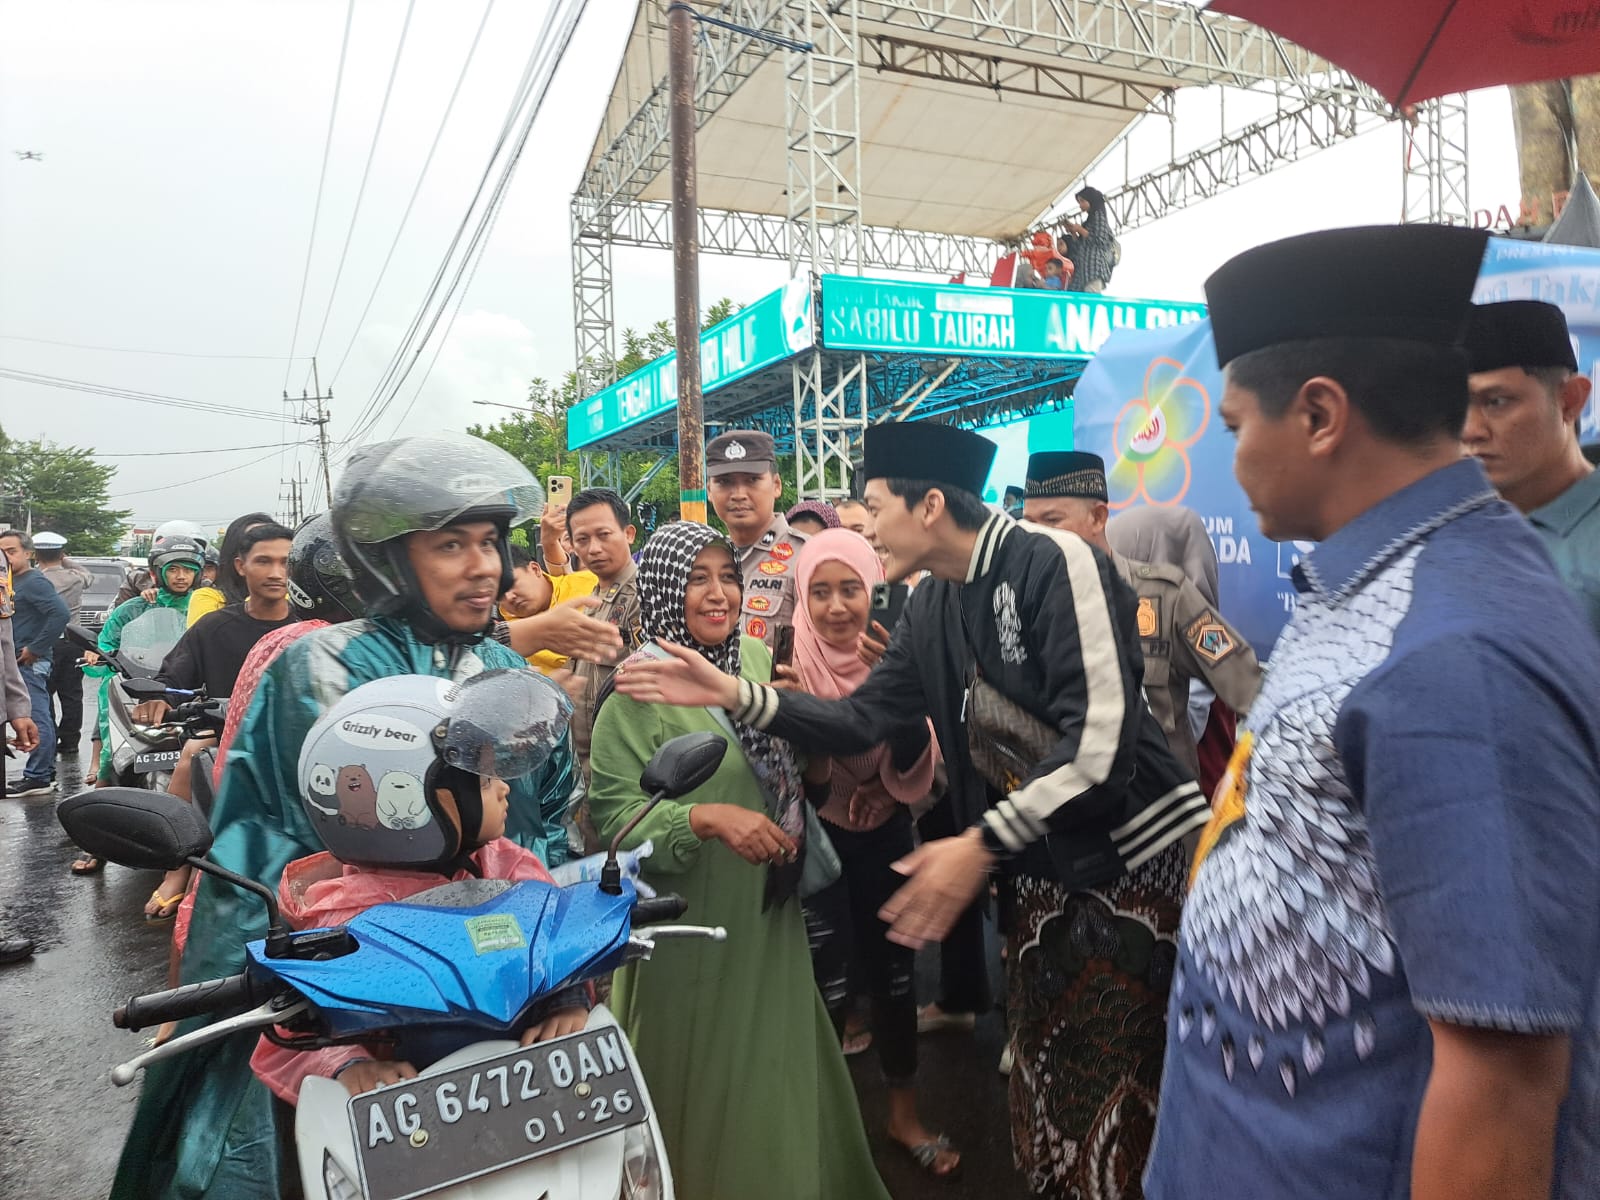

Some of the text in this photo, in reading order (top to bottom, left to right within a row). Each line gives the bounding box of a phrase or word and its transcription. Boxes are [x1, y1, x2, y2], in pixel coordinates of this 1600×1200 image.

[831, 304, 1015, 349] SABILU TAUBAH
[1209, 535, 1252, 565] DA
[749, 578, 783, 590] POLRI
[342, 720, 418, 743] Grizzly bear
[136, 751, 181, 764] AG 2033
[368, 1093, 422, 1148] AG
[435, 1059, 542, 1124] 6472
